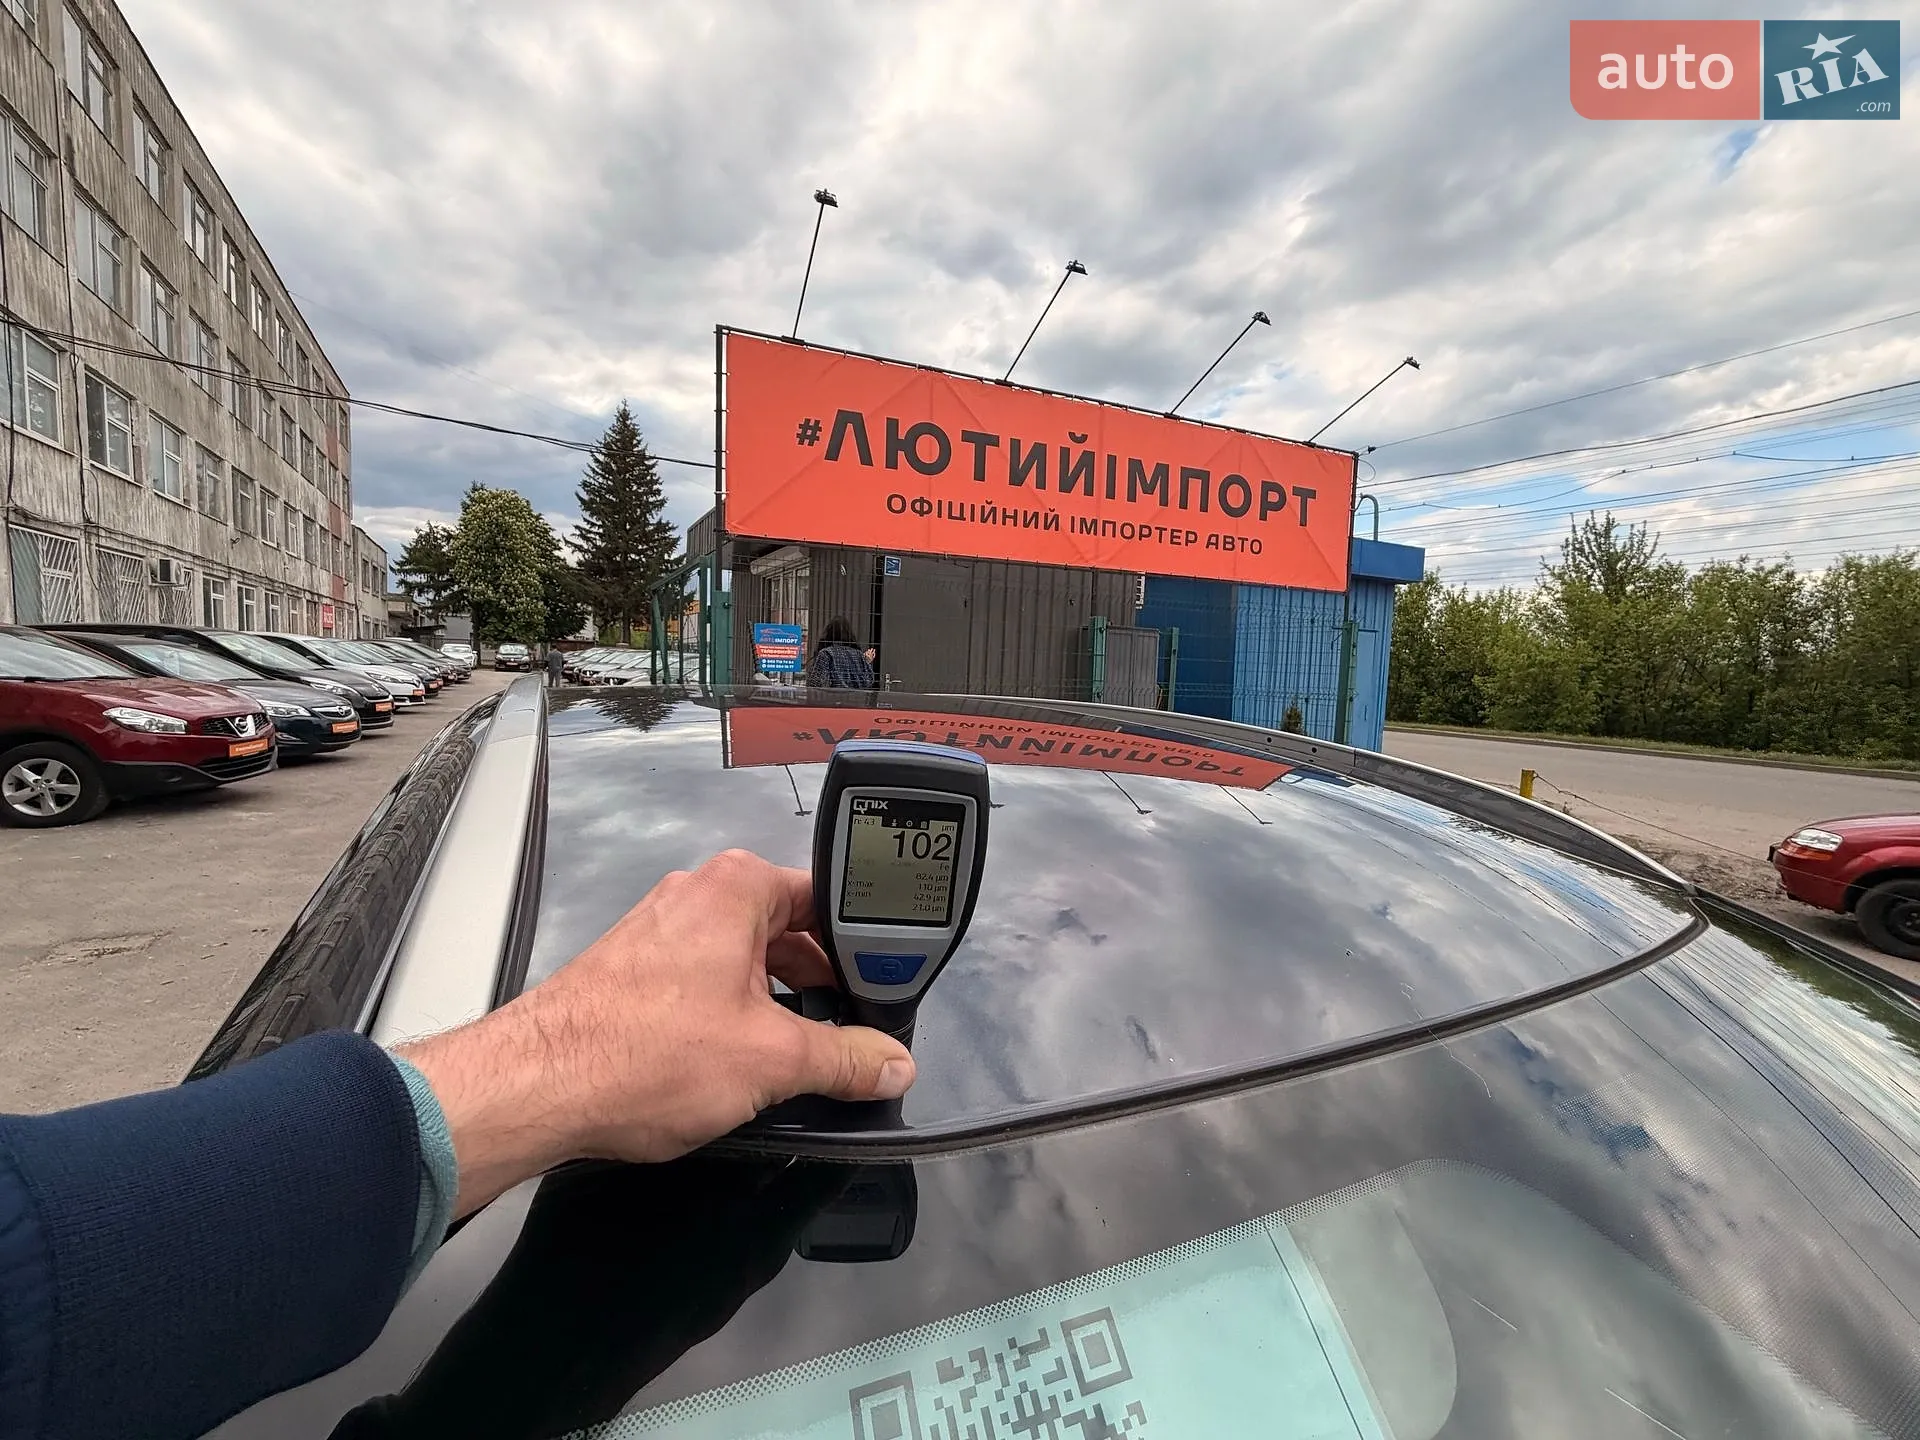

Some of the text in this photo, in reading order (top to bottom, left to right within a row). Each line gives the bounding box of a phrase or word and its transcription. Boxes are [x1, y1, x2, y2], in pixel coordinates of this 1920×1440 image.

[796, 408, 1317, 527] #ЛЮТИЙІМПОРТ
[886, 493, 1263, 555] ОФІЦІЙНИЙ ІМПОРТЕР АВТО
[893, 830, 952, 861] 102
